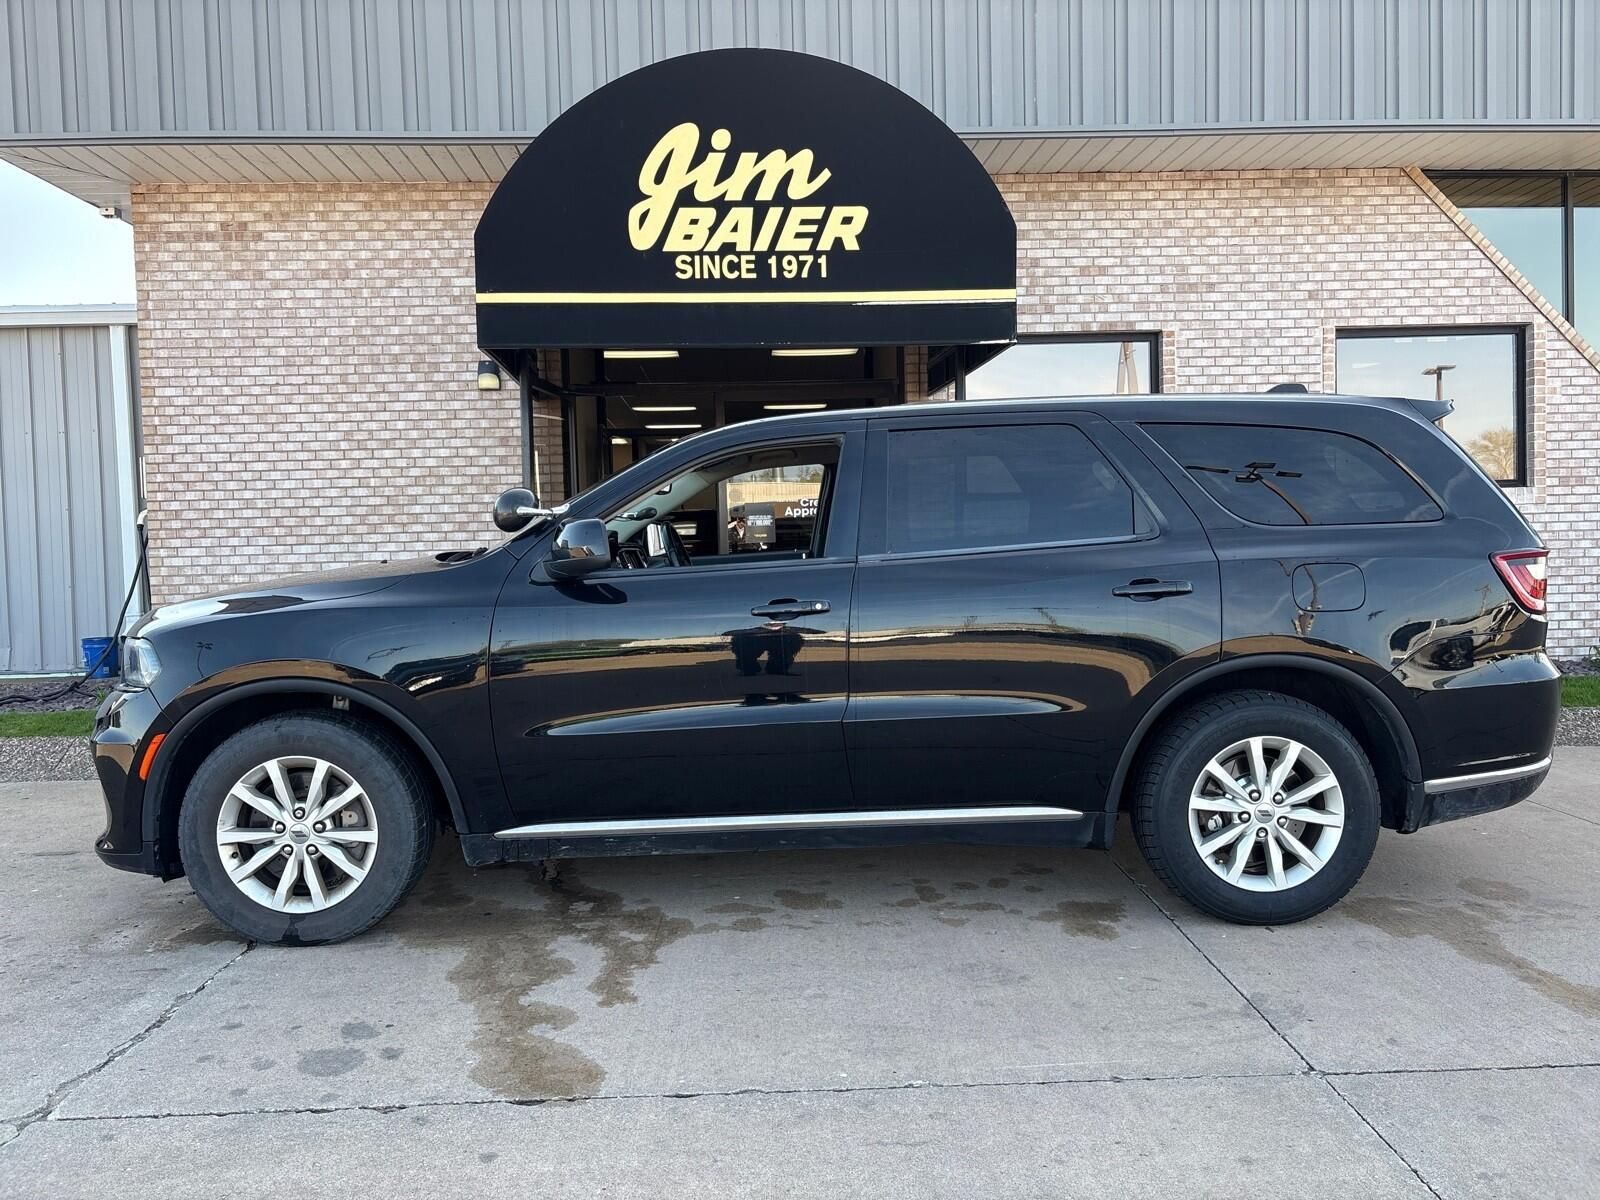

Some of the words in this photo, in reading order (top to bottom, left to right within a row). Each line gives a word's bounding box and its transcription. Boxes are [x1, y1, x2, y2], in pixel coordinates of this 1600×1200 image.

[628, 122, 832, 250] Jim
[662, 206, 869, 252] BAIER
[675, 254, 757, 279] SINCE
[767, 254, 828, 279] 1971
